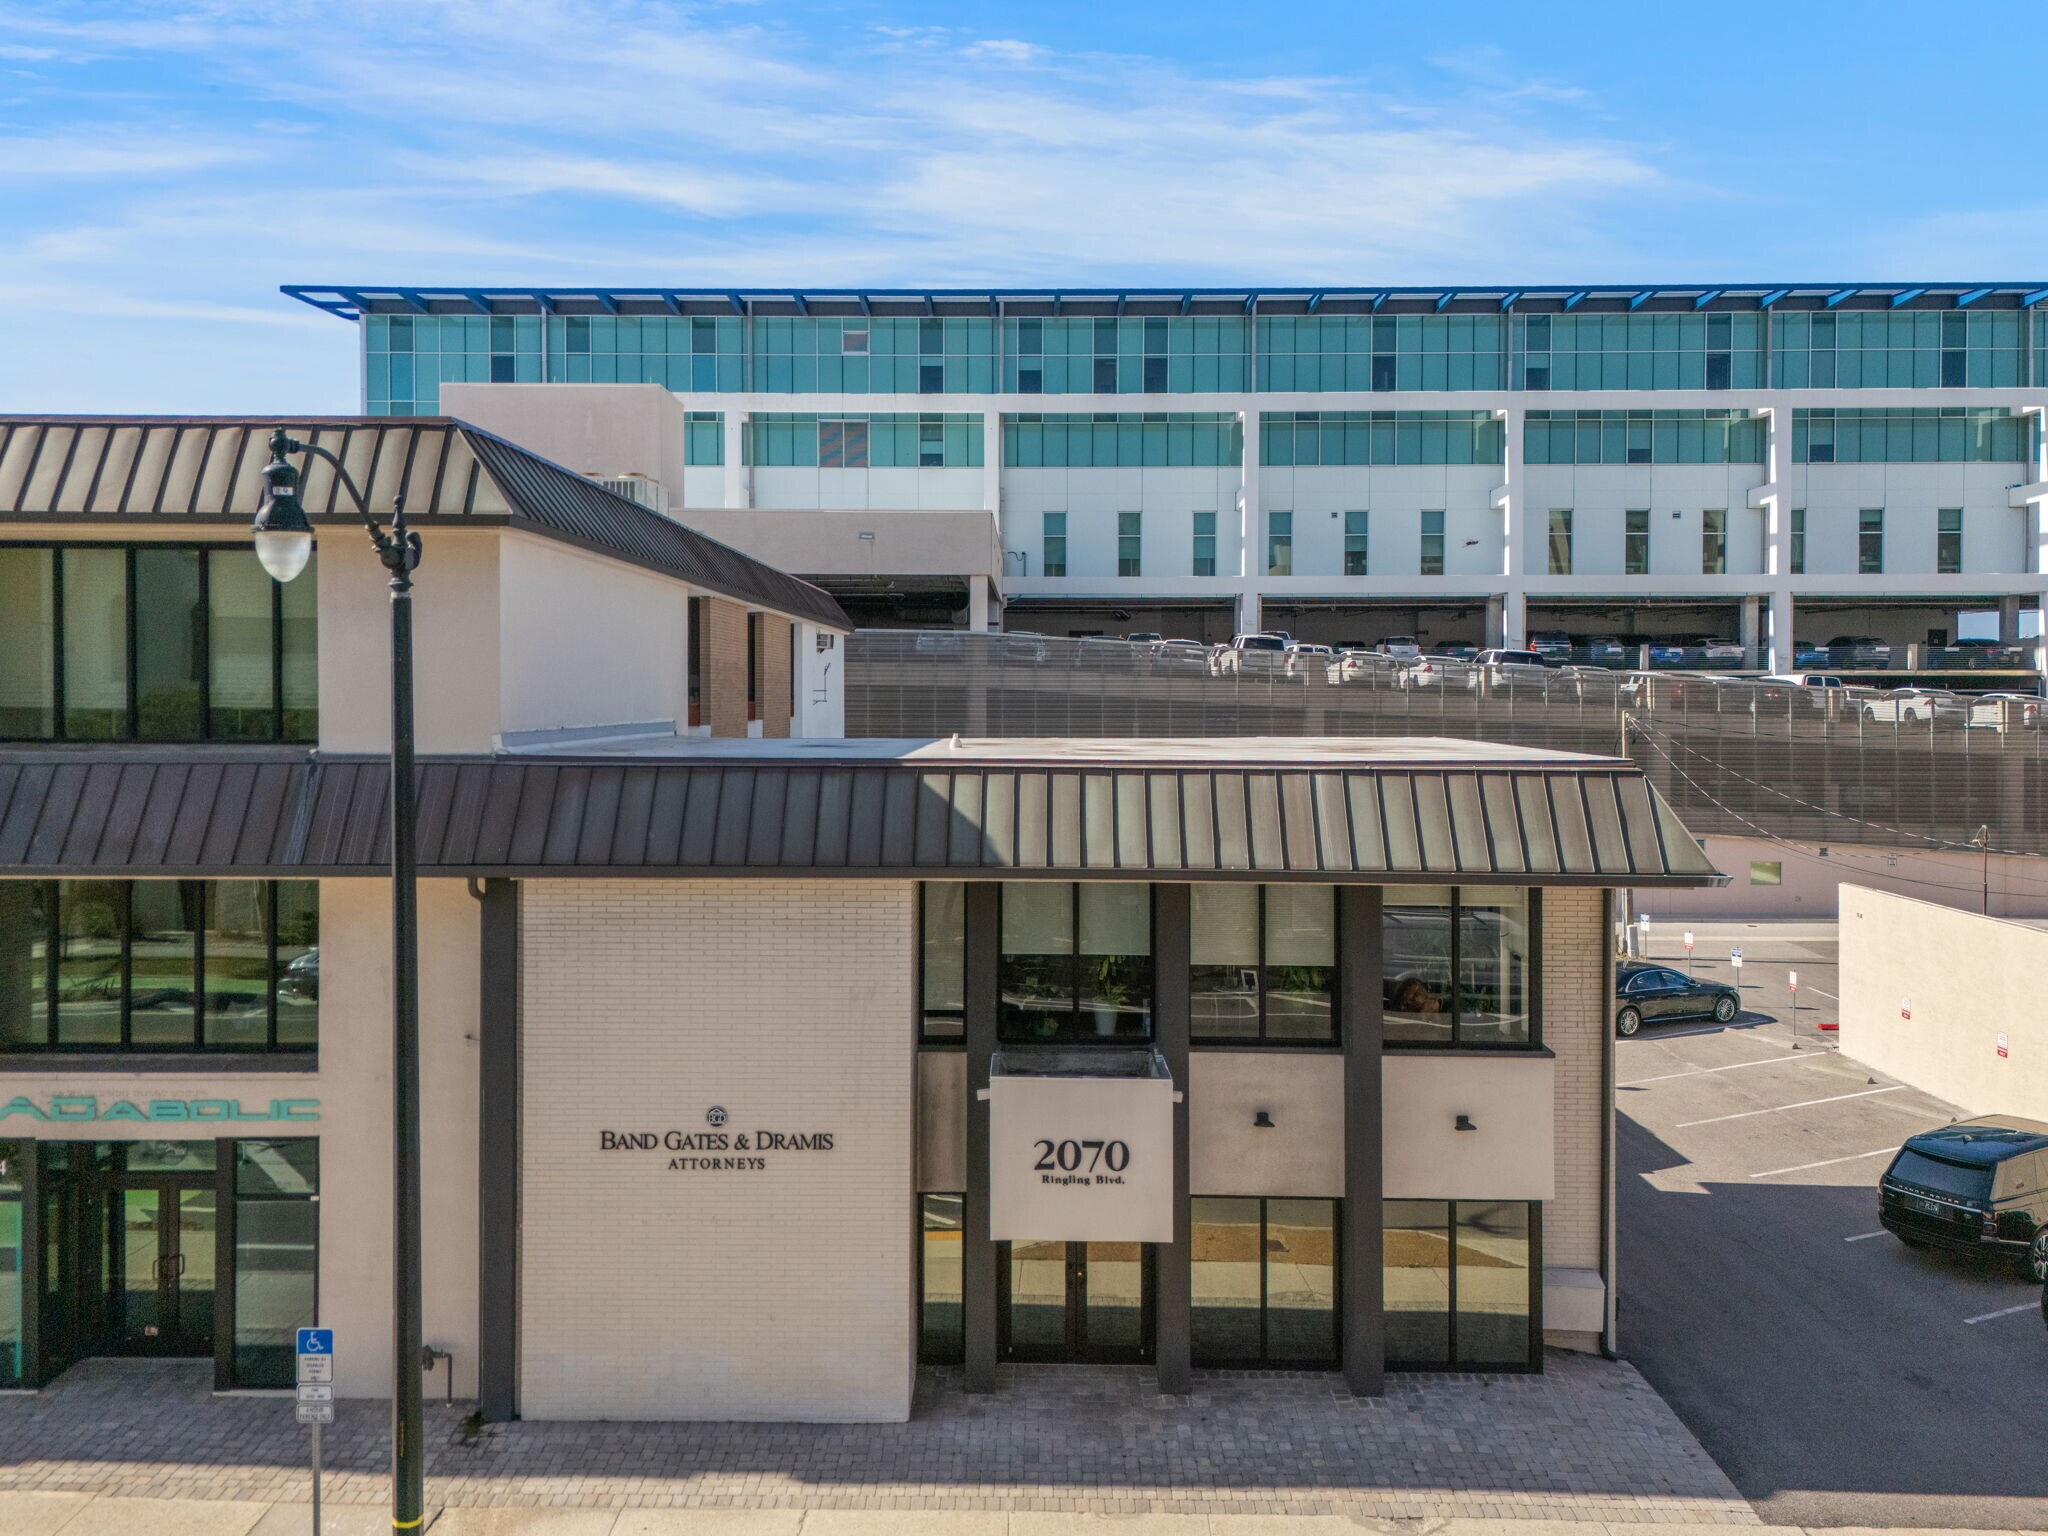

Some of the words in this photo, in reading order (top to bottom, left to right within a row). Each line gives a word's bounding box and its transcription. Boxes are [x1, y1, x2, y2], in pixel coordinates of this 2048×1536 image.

[600, 1131, 658, 1151] BAND
[664, 1131, 728, 1151] GATES
[734, 1134, 750, 1151] &
[756, 1131, 834, 1151] DRAMIS
[1033, 1139, 1130, 1173] 2070
[668, 1158, 766, 1171] ATTORNEYS
[1041, 1175, 1090, 1186] Ringling
[1096, 1175, 1126, 1185] Blvd.
